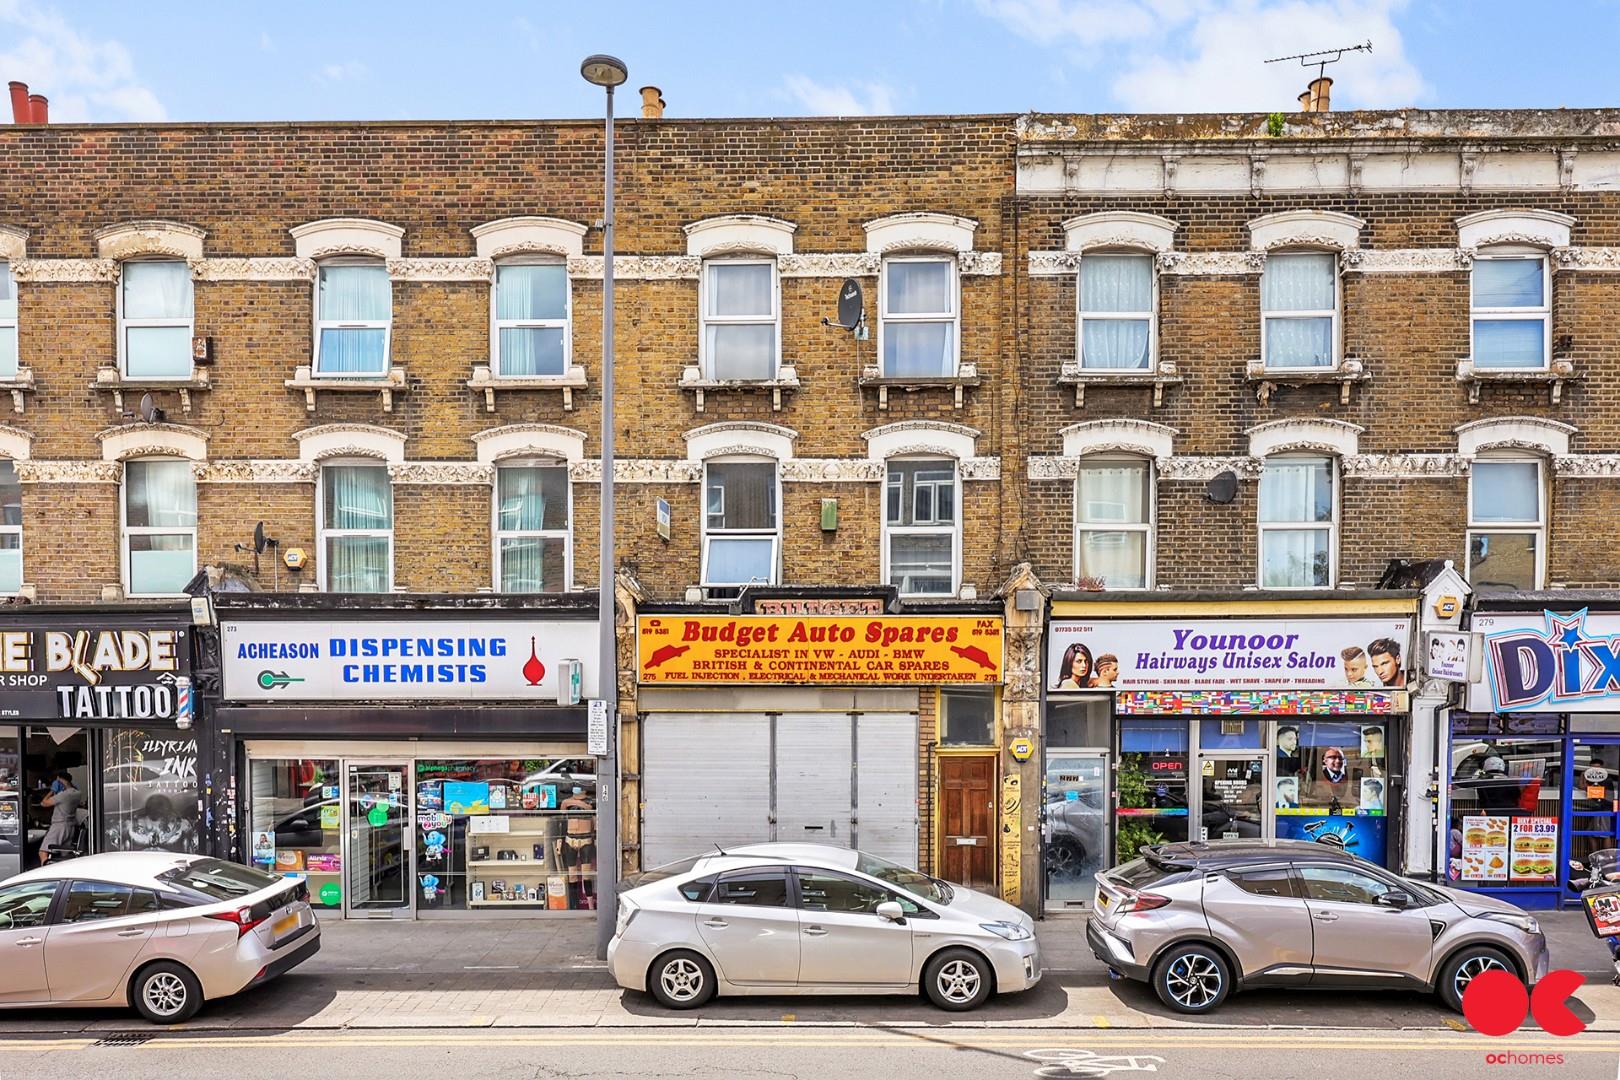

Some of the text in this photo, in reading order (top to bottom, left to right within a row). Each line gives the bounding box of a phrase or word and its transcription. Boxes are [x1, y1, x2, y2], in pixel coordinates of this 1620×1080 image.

[977, 620, 993, 628] FAX
[1478, 618, 1494, 626] 279
[682, 621, 958, 647] Budget Auto Spares
[1173, 630, 1298, 650] Younoor
[0, 631, 178, 680] E BLADE
[238, 643, 319, 659] ACHEASON
[330, 638, 506, 657] DISPENSING
[714, 650, 925, 658] SPECIALIST IN VW AUDI BMW
[693, 661, 950, 670] BRITISH & CONTINENTAL CAR SPARES
[1135, 651, 1336, 673] Hairways Unisex Salon
[9, 675, 48, 686] SHOP
[343, 664, 487, 683] CHEMISTS
[915, 673, 976, 681] UNDERTAKEN
[57, 686, 171, 718] TATTOO
[142, 738, 198, 757] ILLYRIAN
[160, 755, 197, 779] INK
[1152, 762, 1183, 770] OPEN
[418, 814, 453, 824] mobility
[1513, 824, 1518, 832] 2
